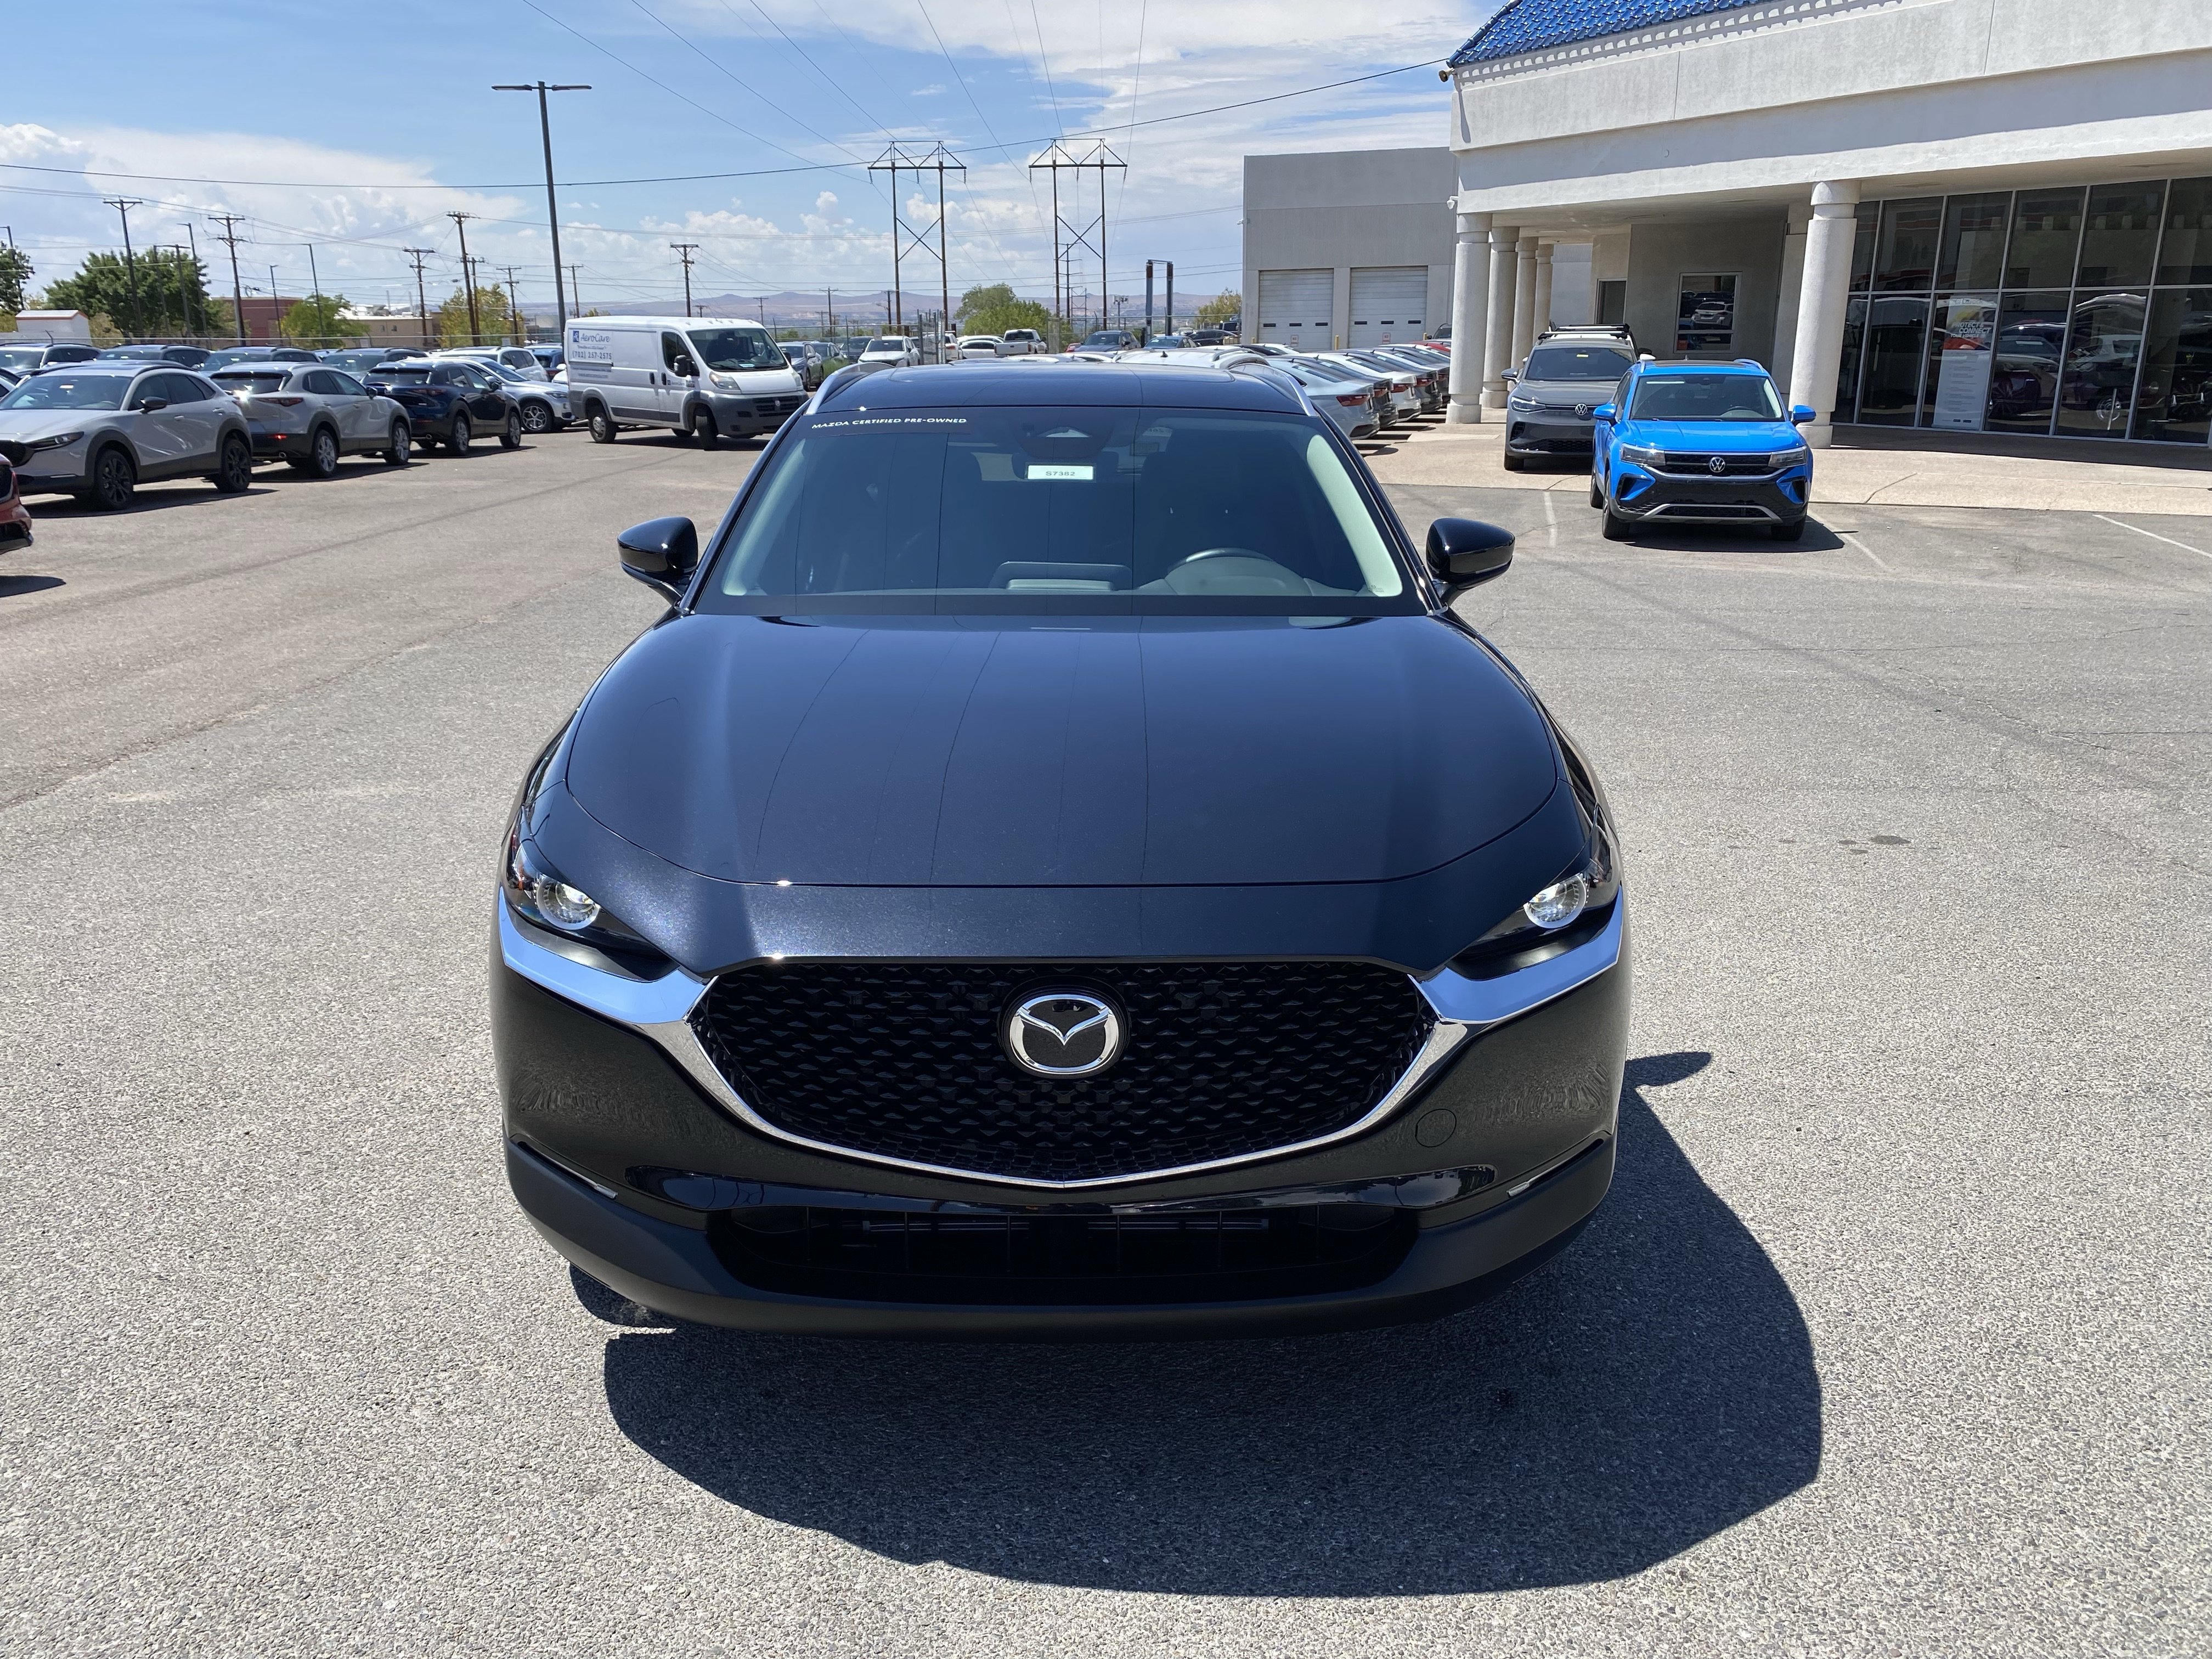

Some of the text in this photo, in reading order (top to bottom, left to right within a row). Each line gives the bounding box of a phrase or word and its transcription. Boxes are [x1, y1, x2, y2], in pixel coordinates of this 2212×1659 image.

[580, 333, 611, 342] AeroCare
[572, 351, 586, 359] (702)
[811, 421, 849, 429] MAZDA
